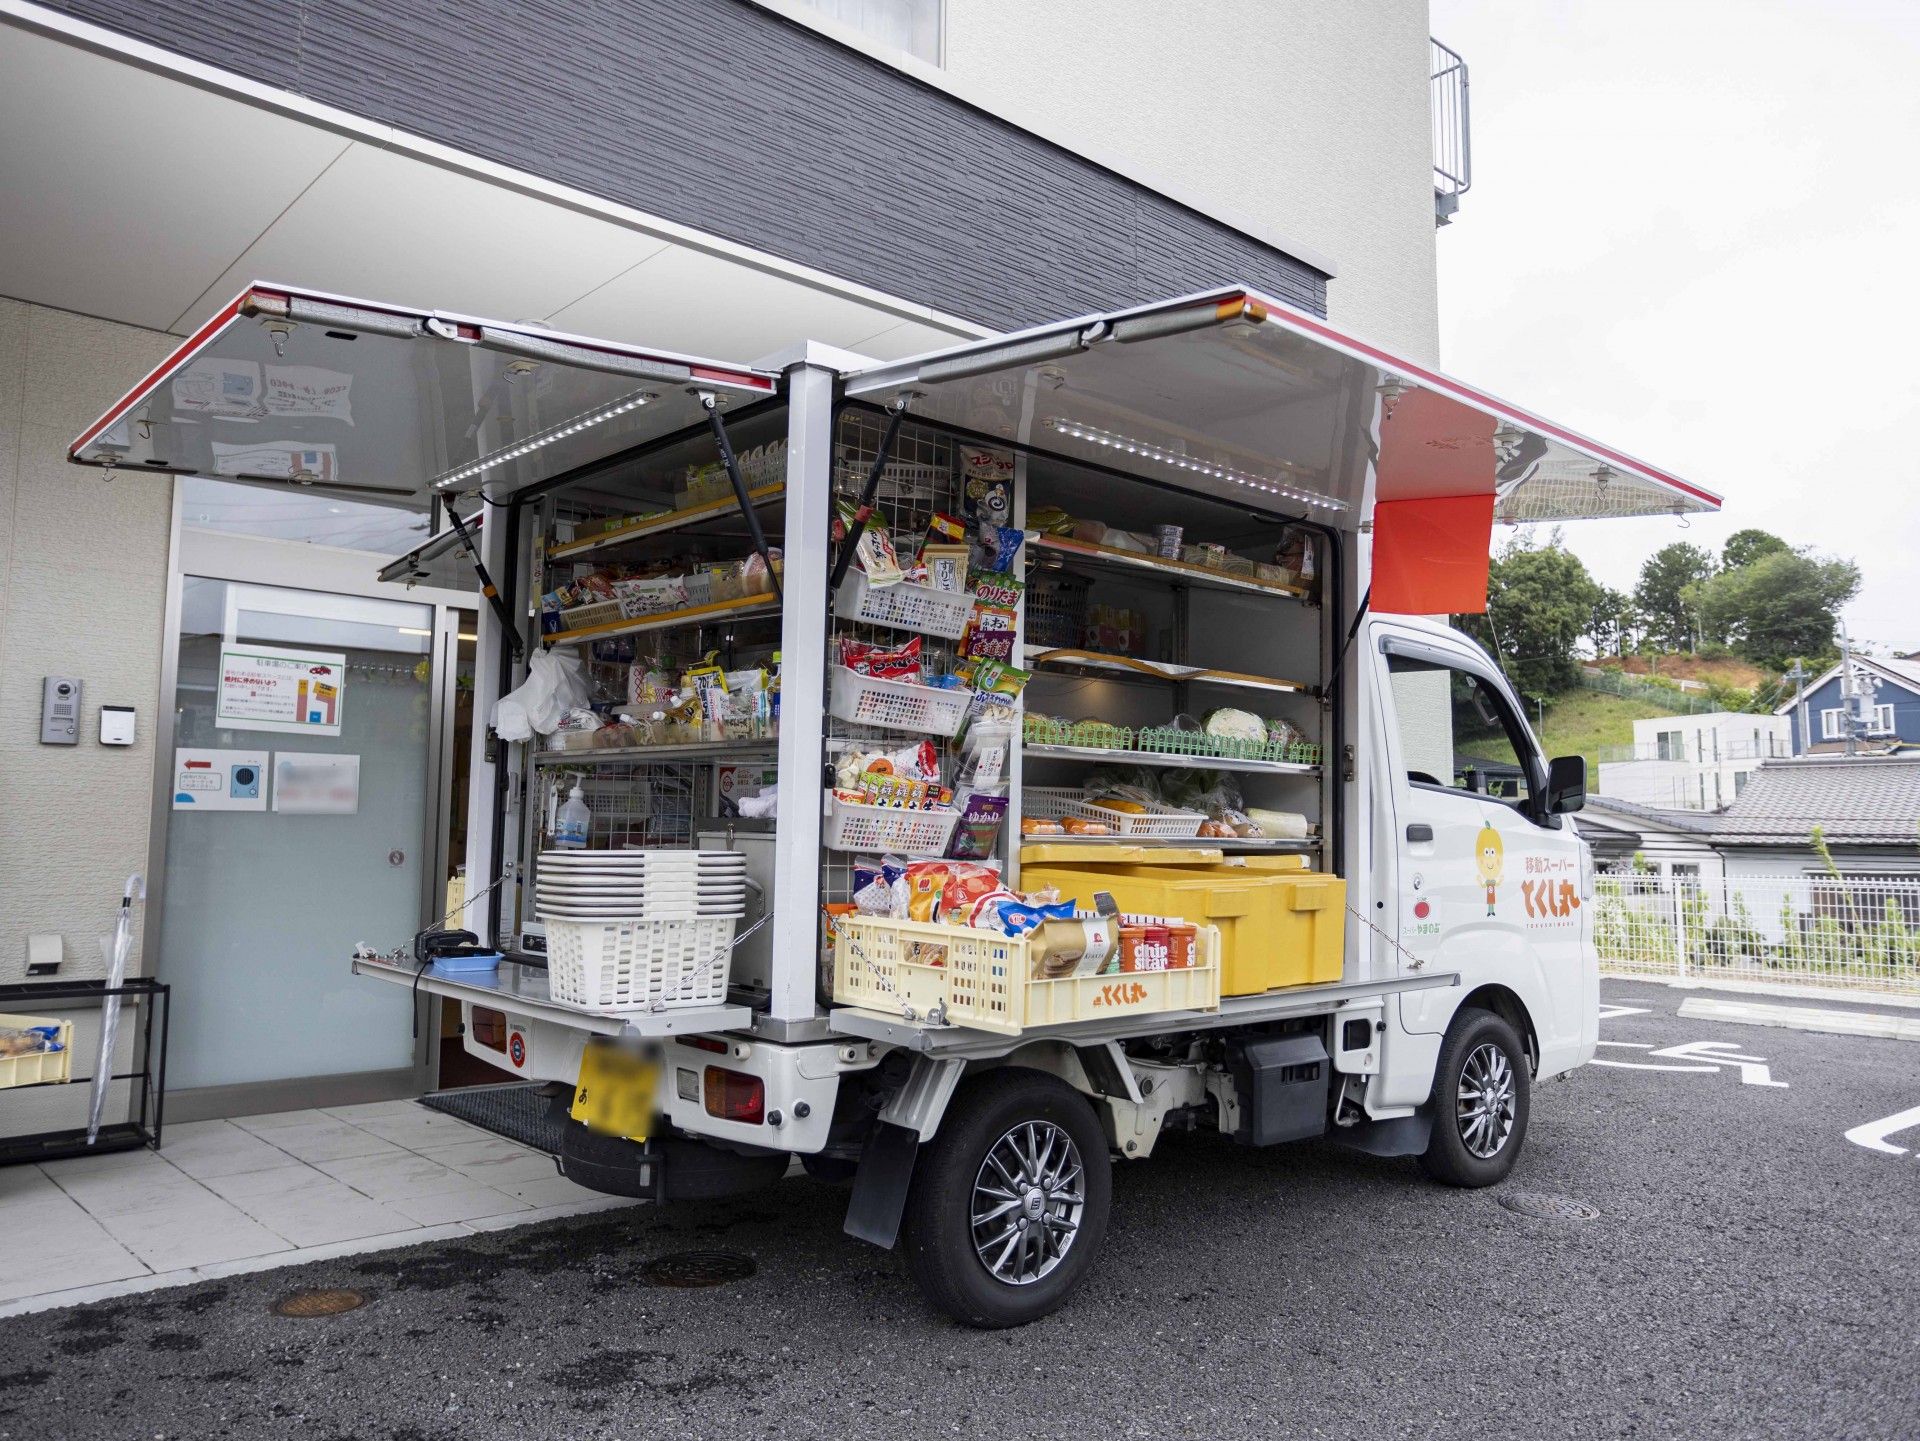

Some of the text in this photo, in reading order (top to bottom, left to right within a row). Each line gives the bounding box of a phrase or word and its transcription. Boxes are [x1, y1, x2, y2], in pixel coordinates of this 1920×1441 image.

[977, 584, 1018, 605] のりたま
[973, 641, 1010, 656] 味道楽
[256, 659, 309, 671] 駐車場のご案内
[968, 810, 1001, 823] ゆかり
[1525, 857, 1575, 874] 移動スーパー
[1520, 879, 1581, 918] とくし丸
[1102, 982, 1148, 1006] とくし丸
